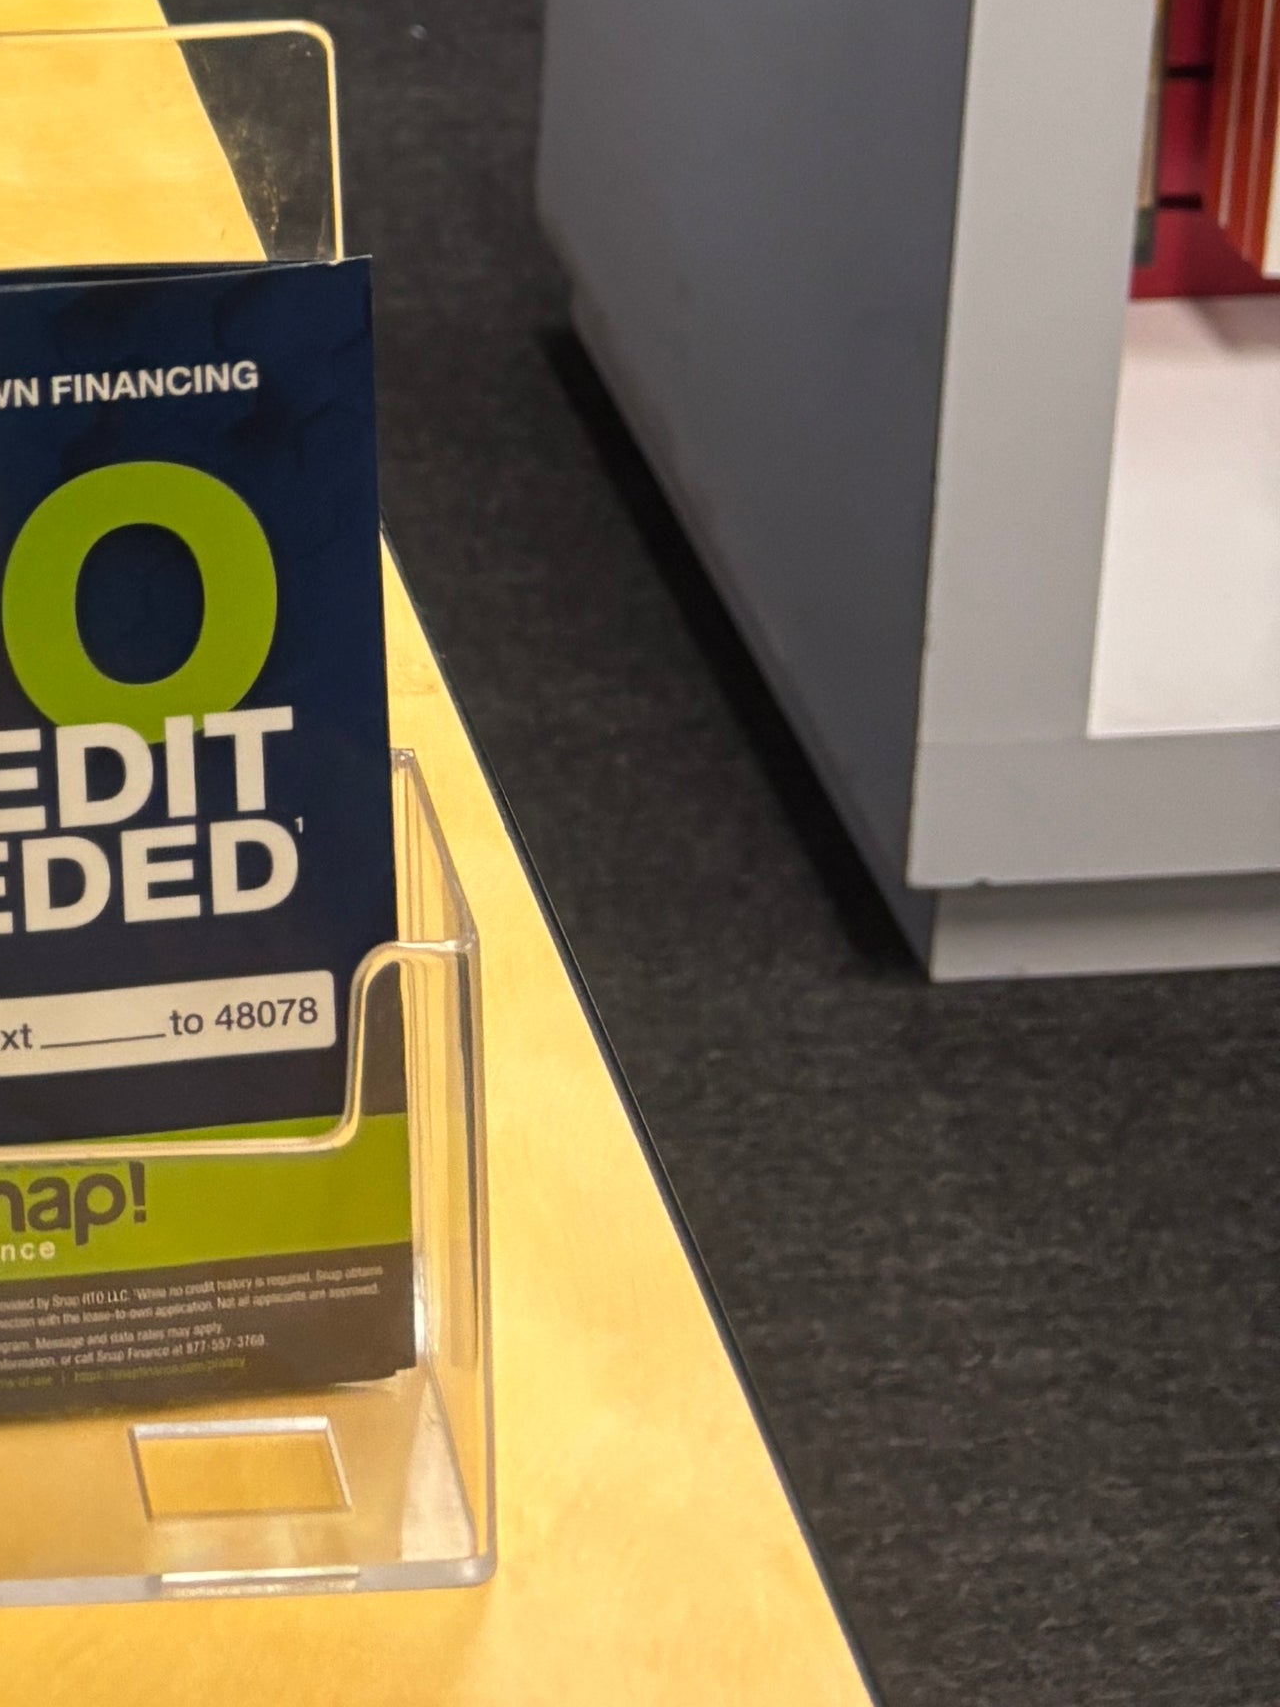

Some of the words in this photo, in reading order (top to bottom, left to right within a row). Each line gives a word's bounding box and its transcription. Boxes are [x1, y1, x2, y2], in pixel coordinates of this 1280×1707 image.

[50, 361, 260, 406] FINANCING
[169, 1004, 205, 1036] to
[215, 995, 320, 1031] 48078
